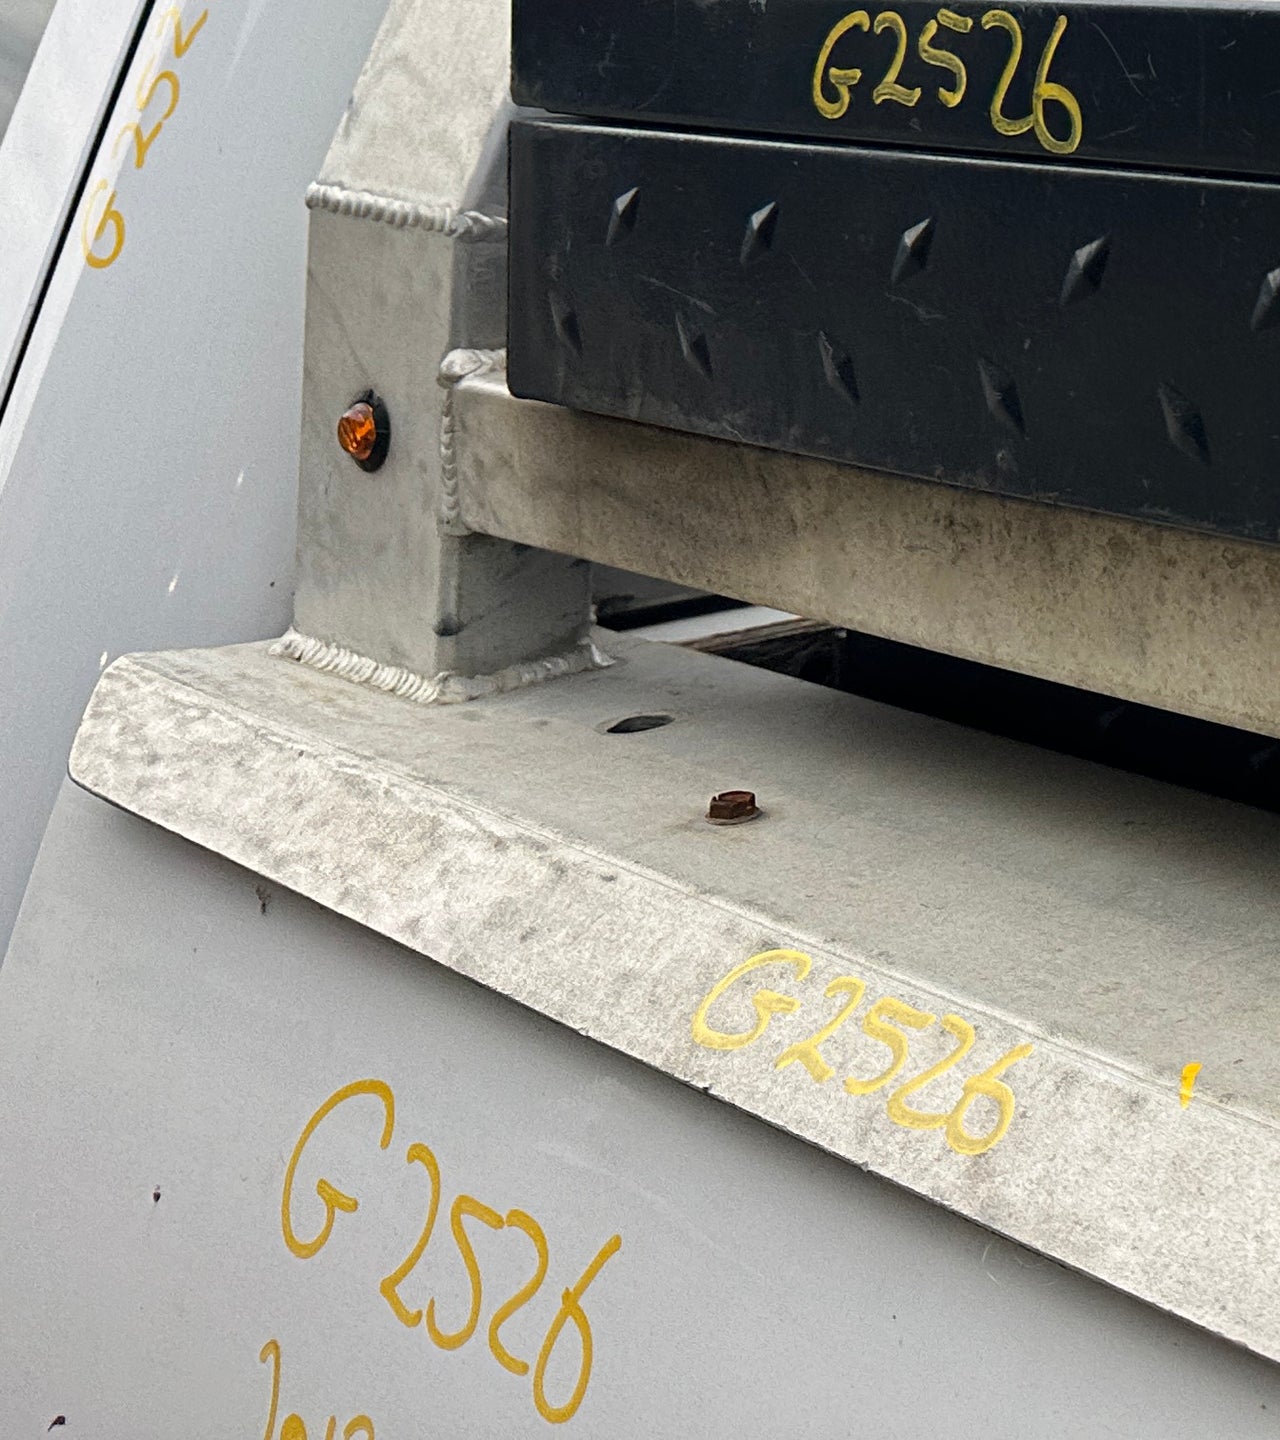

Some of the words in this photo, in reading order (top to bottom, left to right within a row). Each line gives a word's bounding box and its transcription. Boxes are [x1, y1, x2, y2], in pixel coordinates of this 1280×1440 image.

[812, 8, 1083, 154] G2526
[692, 948, 1034, 1156] G2526
[281, 1078, 622, 1424] G2526
